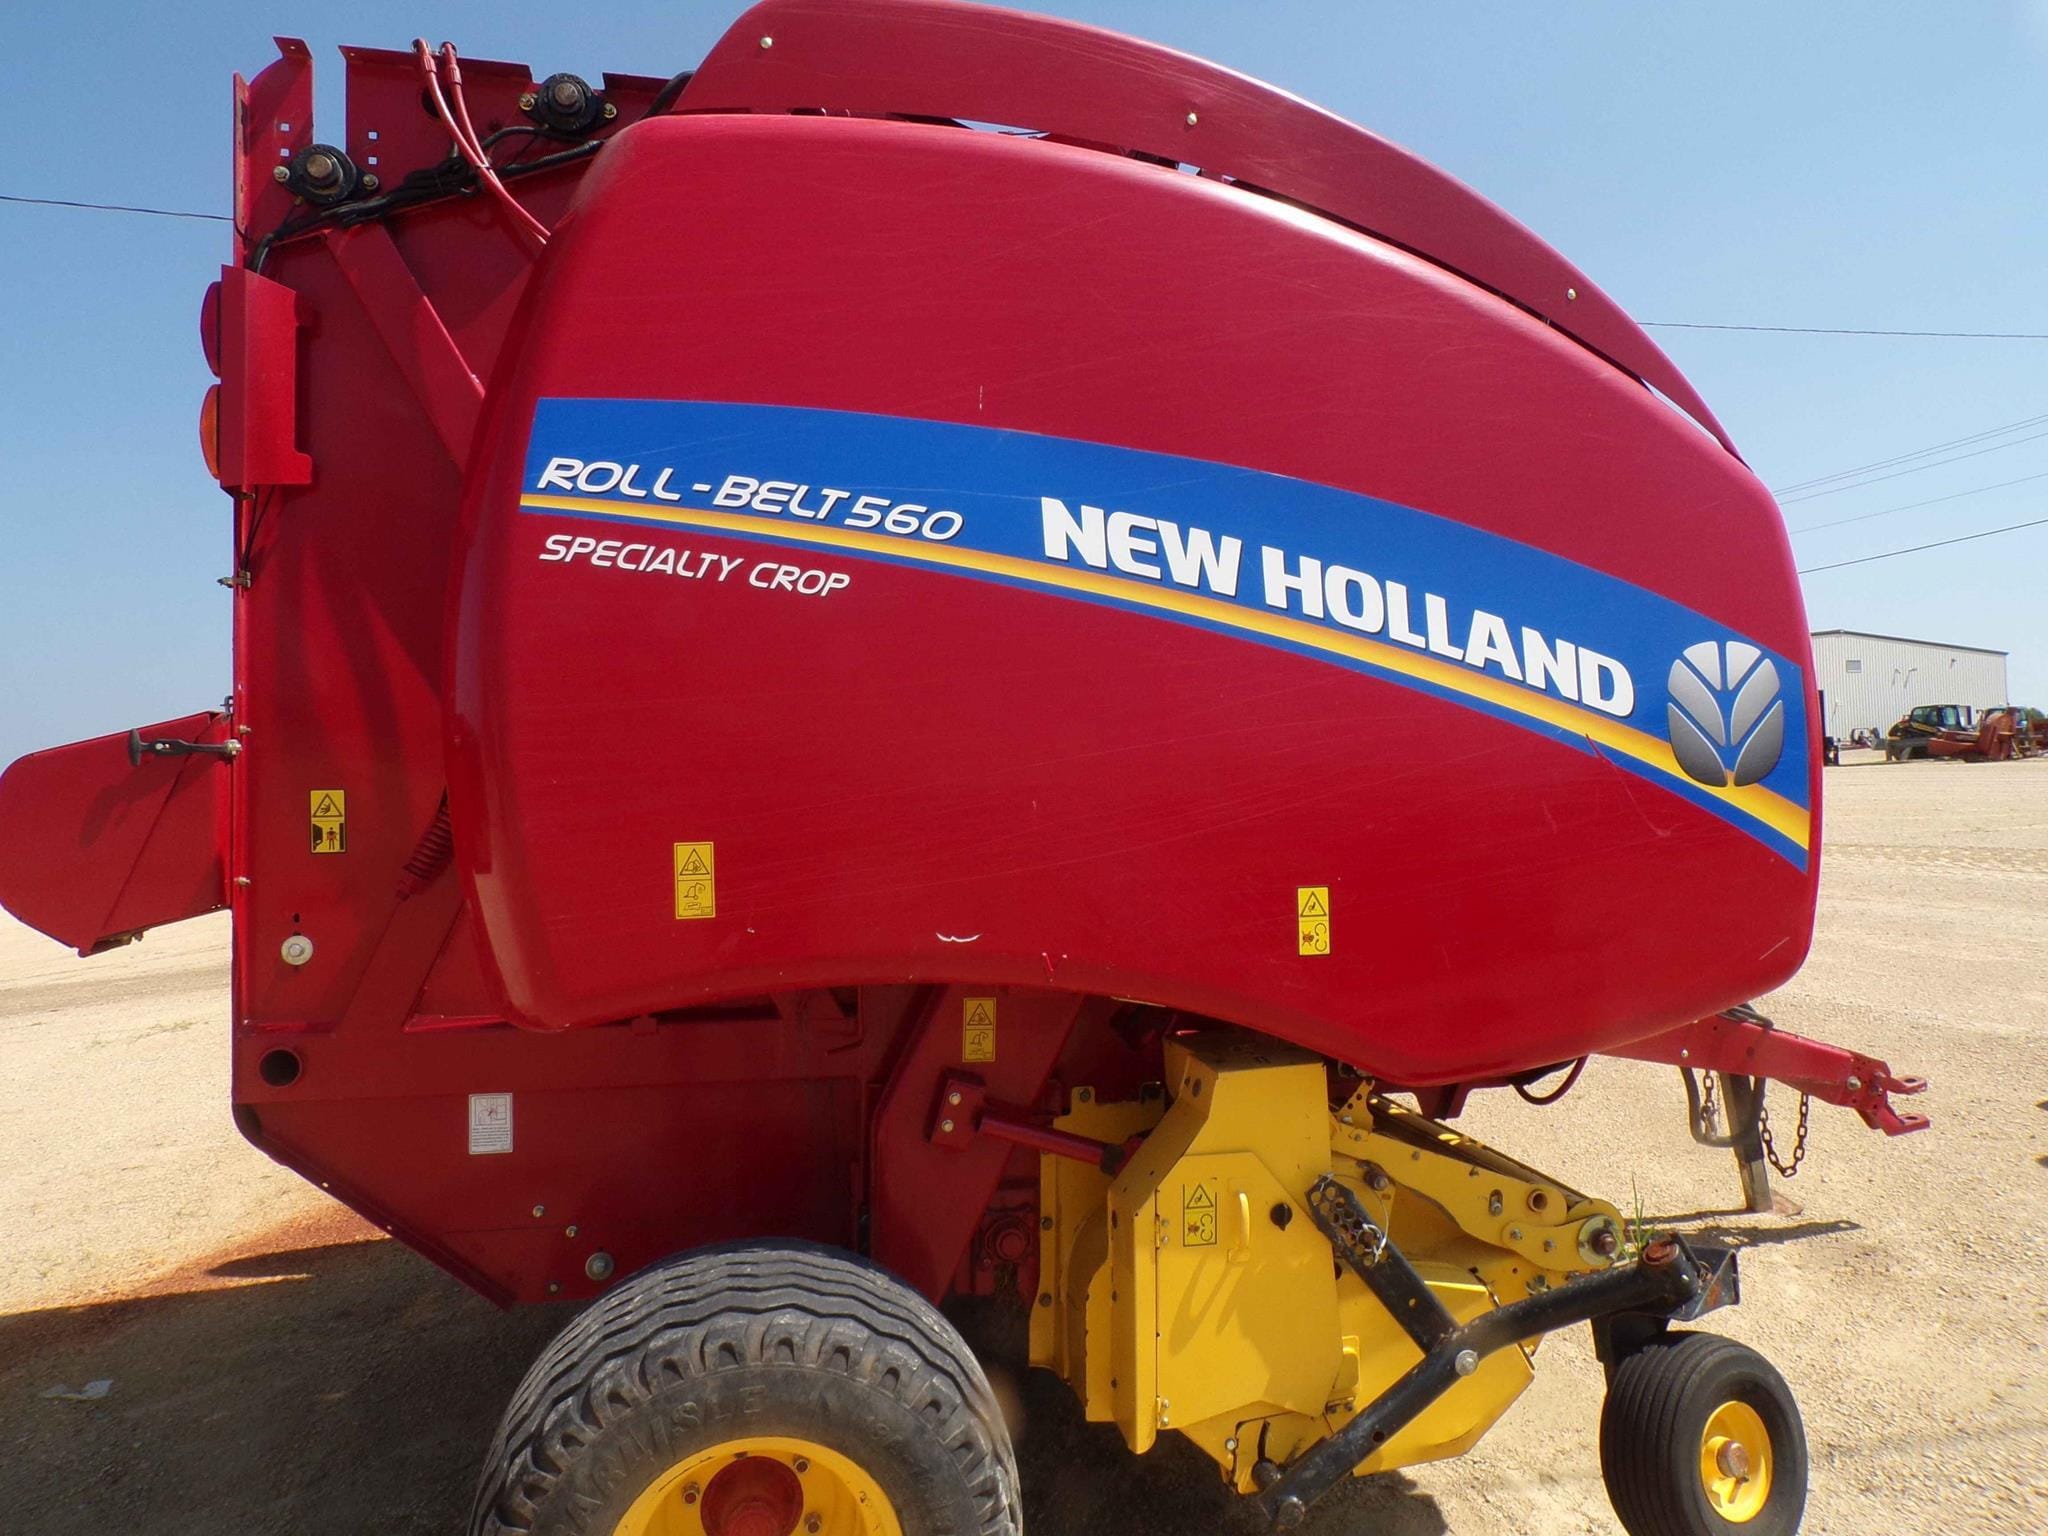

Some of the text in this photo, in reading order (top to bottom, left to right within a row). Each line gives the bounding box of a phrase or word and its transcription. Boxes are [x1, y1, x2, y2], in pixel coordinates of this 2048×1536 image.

[844, 496, 964, 540] 560
[539, 535, 851, 597] SPECIALTY CROP
[1040, 496, 1636, 718] NEW HOLLAND
